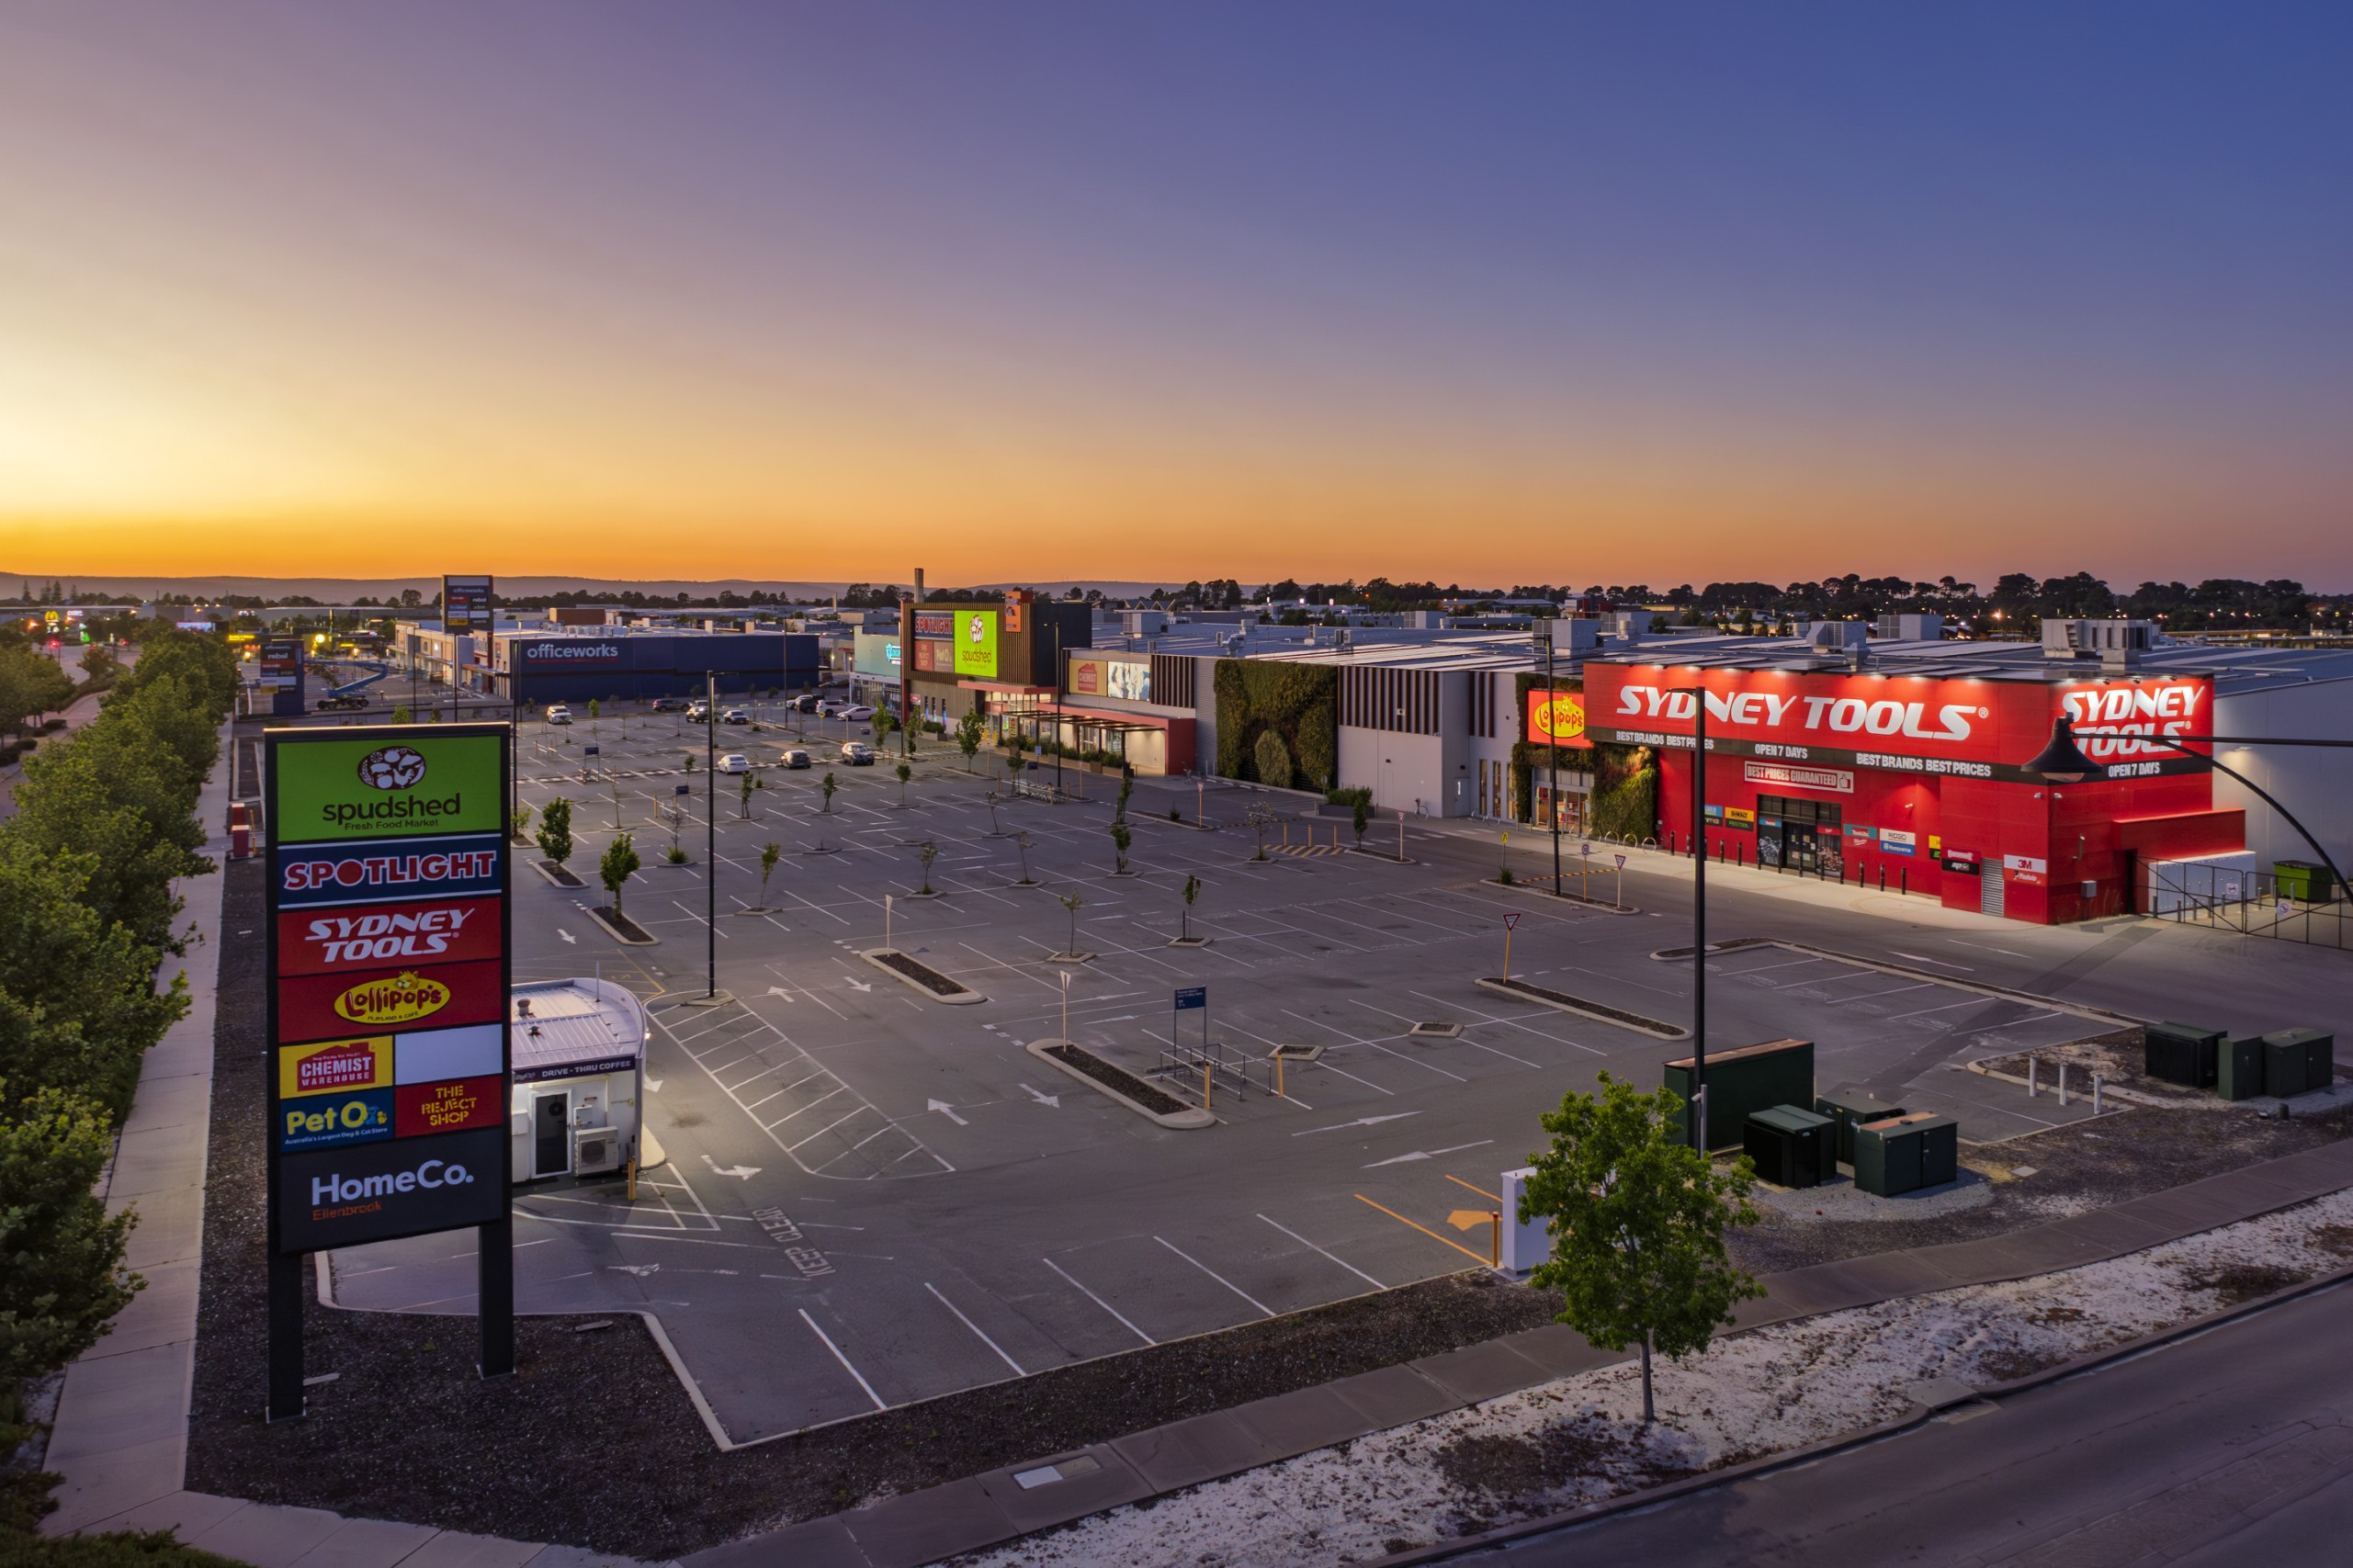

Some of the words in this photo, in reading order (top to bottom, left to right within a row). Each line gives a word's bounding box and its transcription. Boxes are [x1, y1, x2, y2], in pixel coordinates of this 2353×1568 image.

[915, 616, 954, 634] SPOTLIGHT
[526, 643, 618, 659] officeworks
[962, 647, 992, 665] spudshed
[1616, 685, 1797, 726] SYDNEY
[1803, 696, 1977, 741] TOOLS
[2060, 685, 2205, 722] SYDNEY
[1635, 732, 1664, 745] BRANDS
[1685, 737, 1714, 750] PRES
[2074, 721, 2185, 757] TOOLS
[1755, 743, 1778, 756] OPEN
[1778, 745, 1783, 757] 7
[1785, 747, 1808, 760] DAYS
[1856, 752, 1881, 766] BEST
[1882, 755, 1923, 771] BRANDS
[1925, 760, 1952, 773] BEST
[1952, 762, 1991, 777] PRICES
[2109, 764, 2132, 778] OPEN
[2132, 763, 2137, 775] 7
[2139, 761, 2160, 775] DAYS
[1747, 765, 1764, 778] BEST
[1765, 767, 1790, 782] PRICES
[1791, 770, 1837, 786] GUARANTEED
[322, 793, 460, 825] spudshed
[345, 822, 373, 830] Fresh
[376, 820, 402, 829] Food
[284, 851, 497, 890] SPOTLIGHT
[2018, 859, 2031, 870] 3M
[305, 908, 475, 941] SYDNEY
[322, 932, 451, 963] TOOLS
[301, 1056, 371, 1077] CHEMIST
[542, 1067, 568, 1077] DRIVE
[574, 1065, 598, 1073] THRU
[599, 1060, 631, 1070] COFFEE
[301, 1072, 369, 1086] WAREHOUSE
[436, 1085, 463, 1098] THE
[422, 1098, 477, 1115] REJECT
[429, 1110, 469, 1126] SHOP
[285, 1135, 317, 1145] Australia's
[318, 1134, 341, 1142] Largest
[311, 1159, 474, 1206] HomeCo.
[312, 1201, 382, 1222] Ellenbrook
[752, 1206, 804, 1243] CLEAR
[785, 1247, 836, 1278] KEEP
